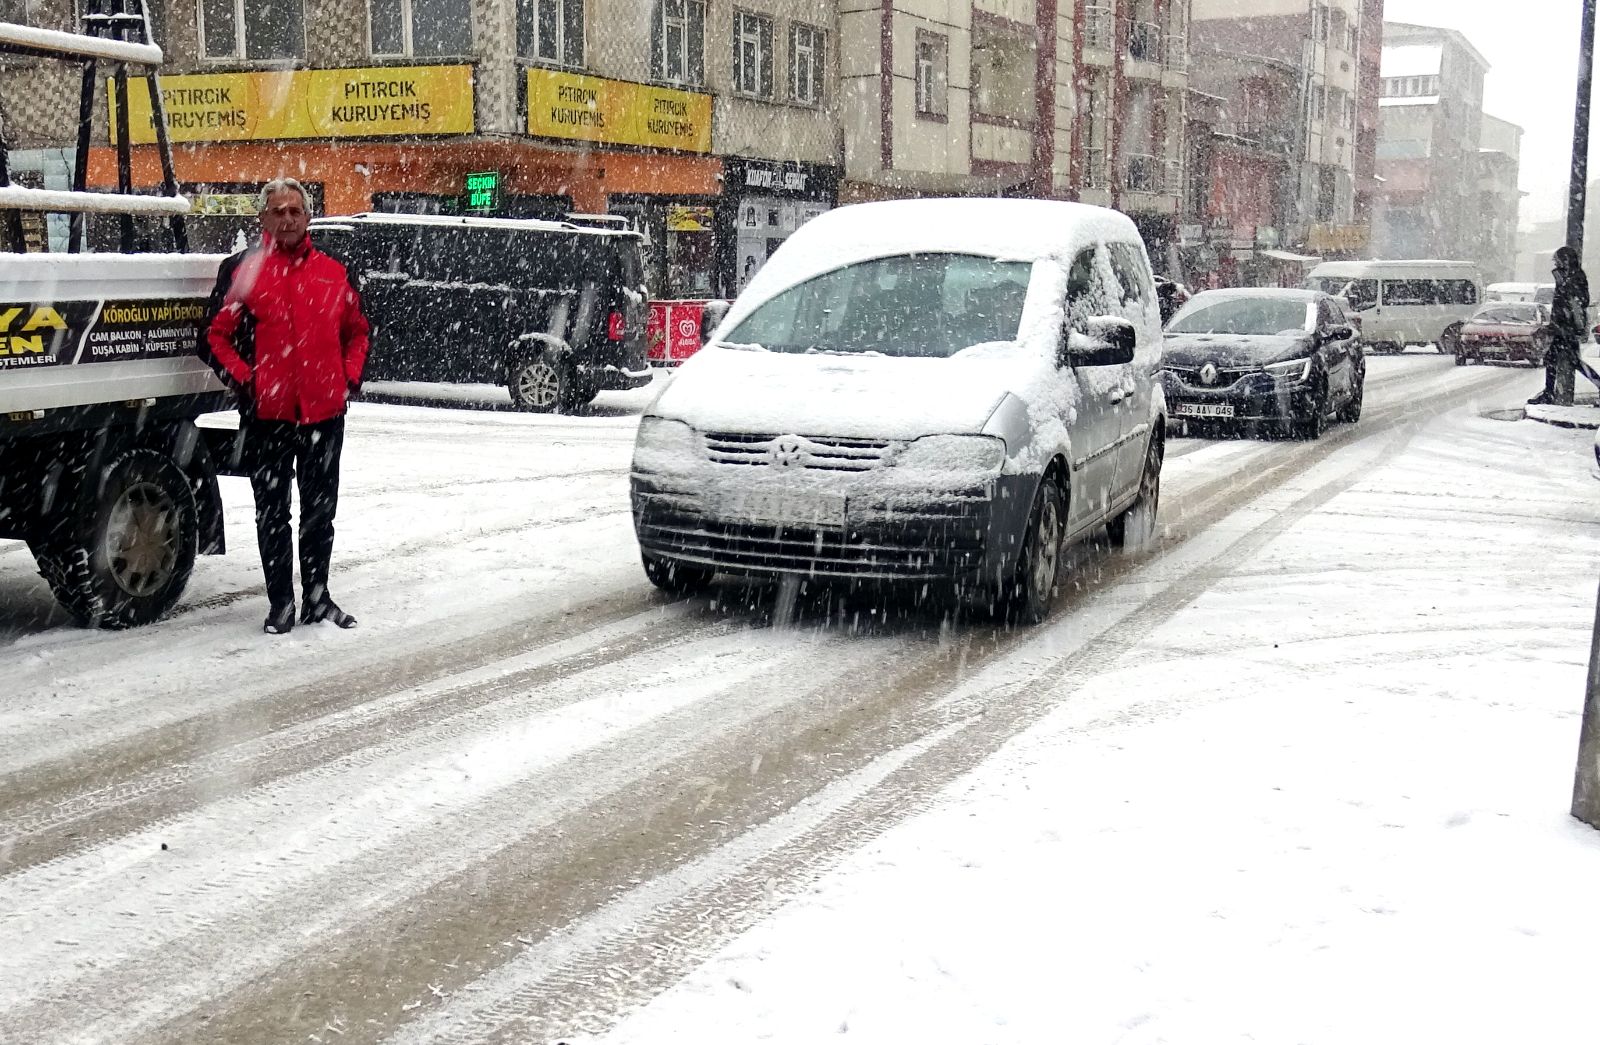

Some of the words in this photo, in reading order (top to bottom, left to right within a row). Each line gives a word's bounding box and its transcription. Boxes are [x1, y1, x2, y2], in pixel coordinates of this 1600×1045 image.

[332, 100, 431, 124] KURUYEMİŞ
[103, 304, 149, 324] KÖROĞLU
[90, 332, 108, 342] CAM
[110, 330, 142, 341] BALKON
[148, 326, 192, 339] ALÜMİNYUM
[92, 344, 114, 357] DUŞA
[115, 341, 139, 354] KABİN
[145, 340, 177, 353] KÜPEŞTE
